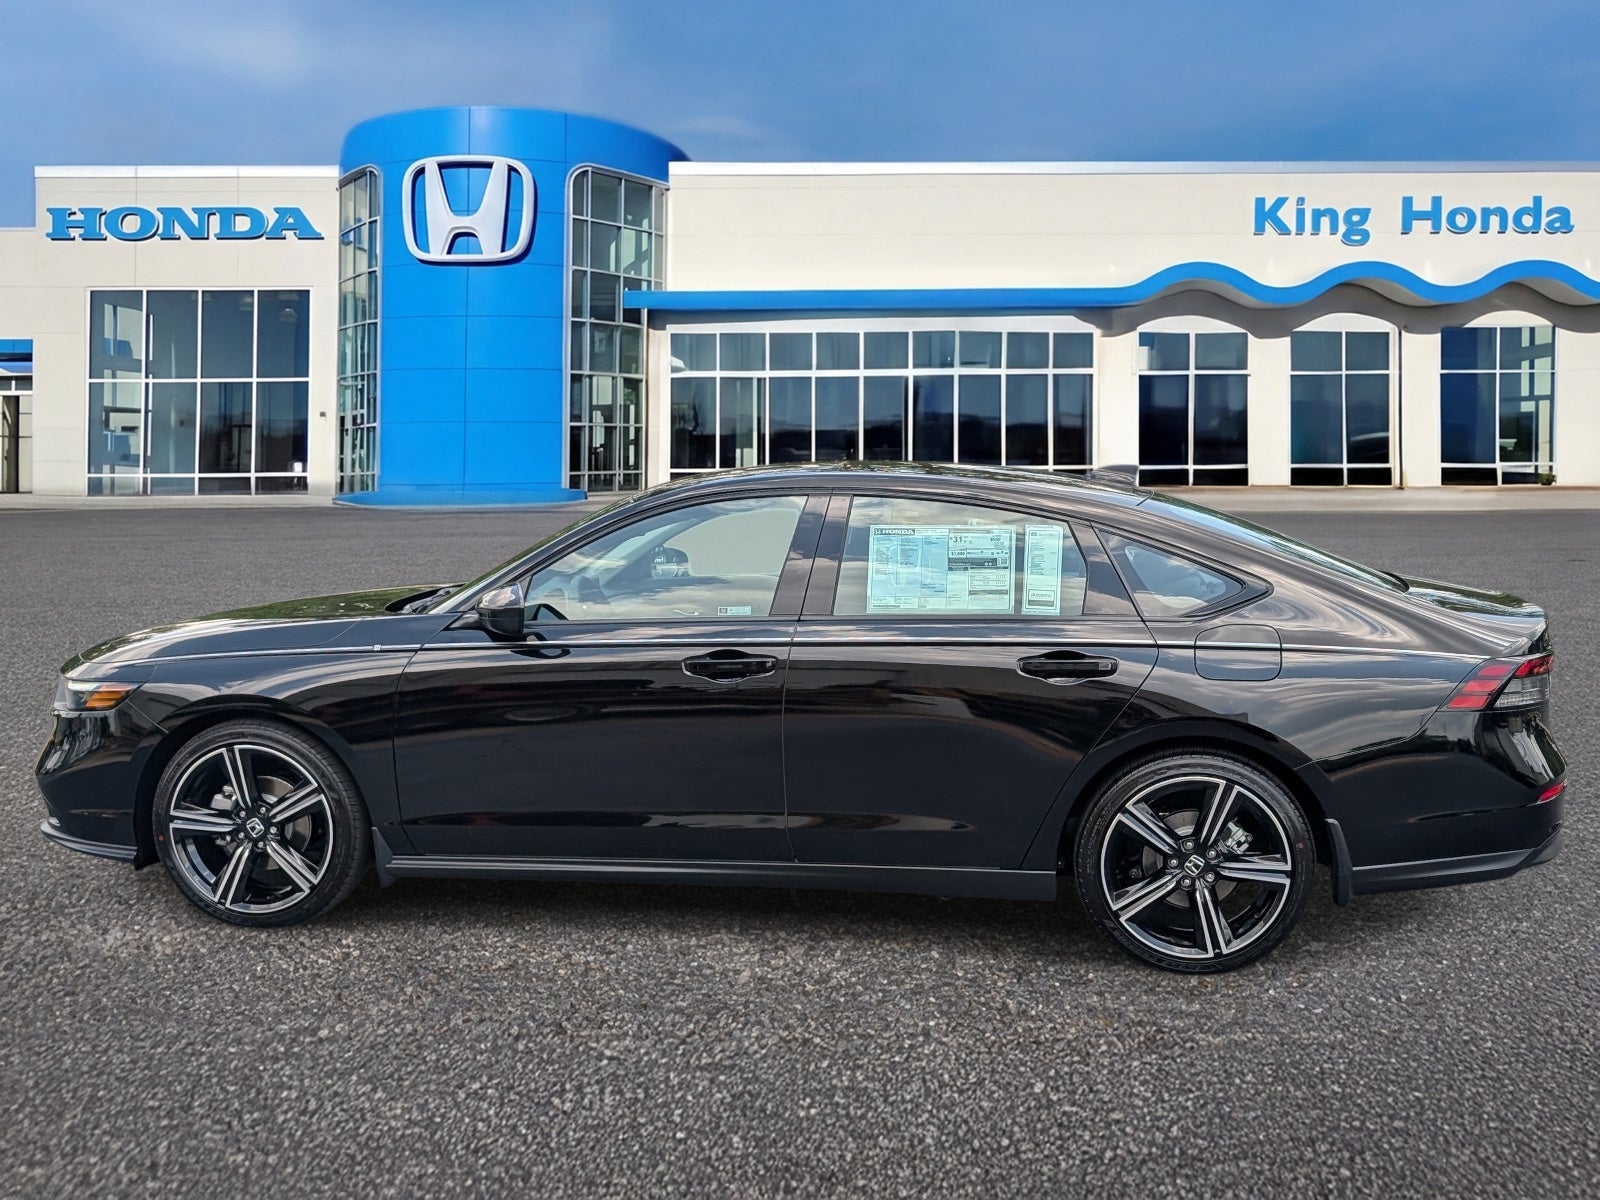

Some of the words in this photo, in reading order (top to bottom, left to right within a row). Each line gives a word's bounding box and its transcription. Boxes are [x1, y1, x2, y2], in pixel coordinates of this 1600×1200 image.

[46, 206, 324, 242] HONDA
[1253, 196, 1372, 246] King
[1400, 195, 1575, 235] Honda
